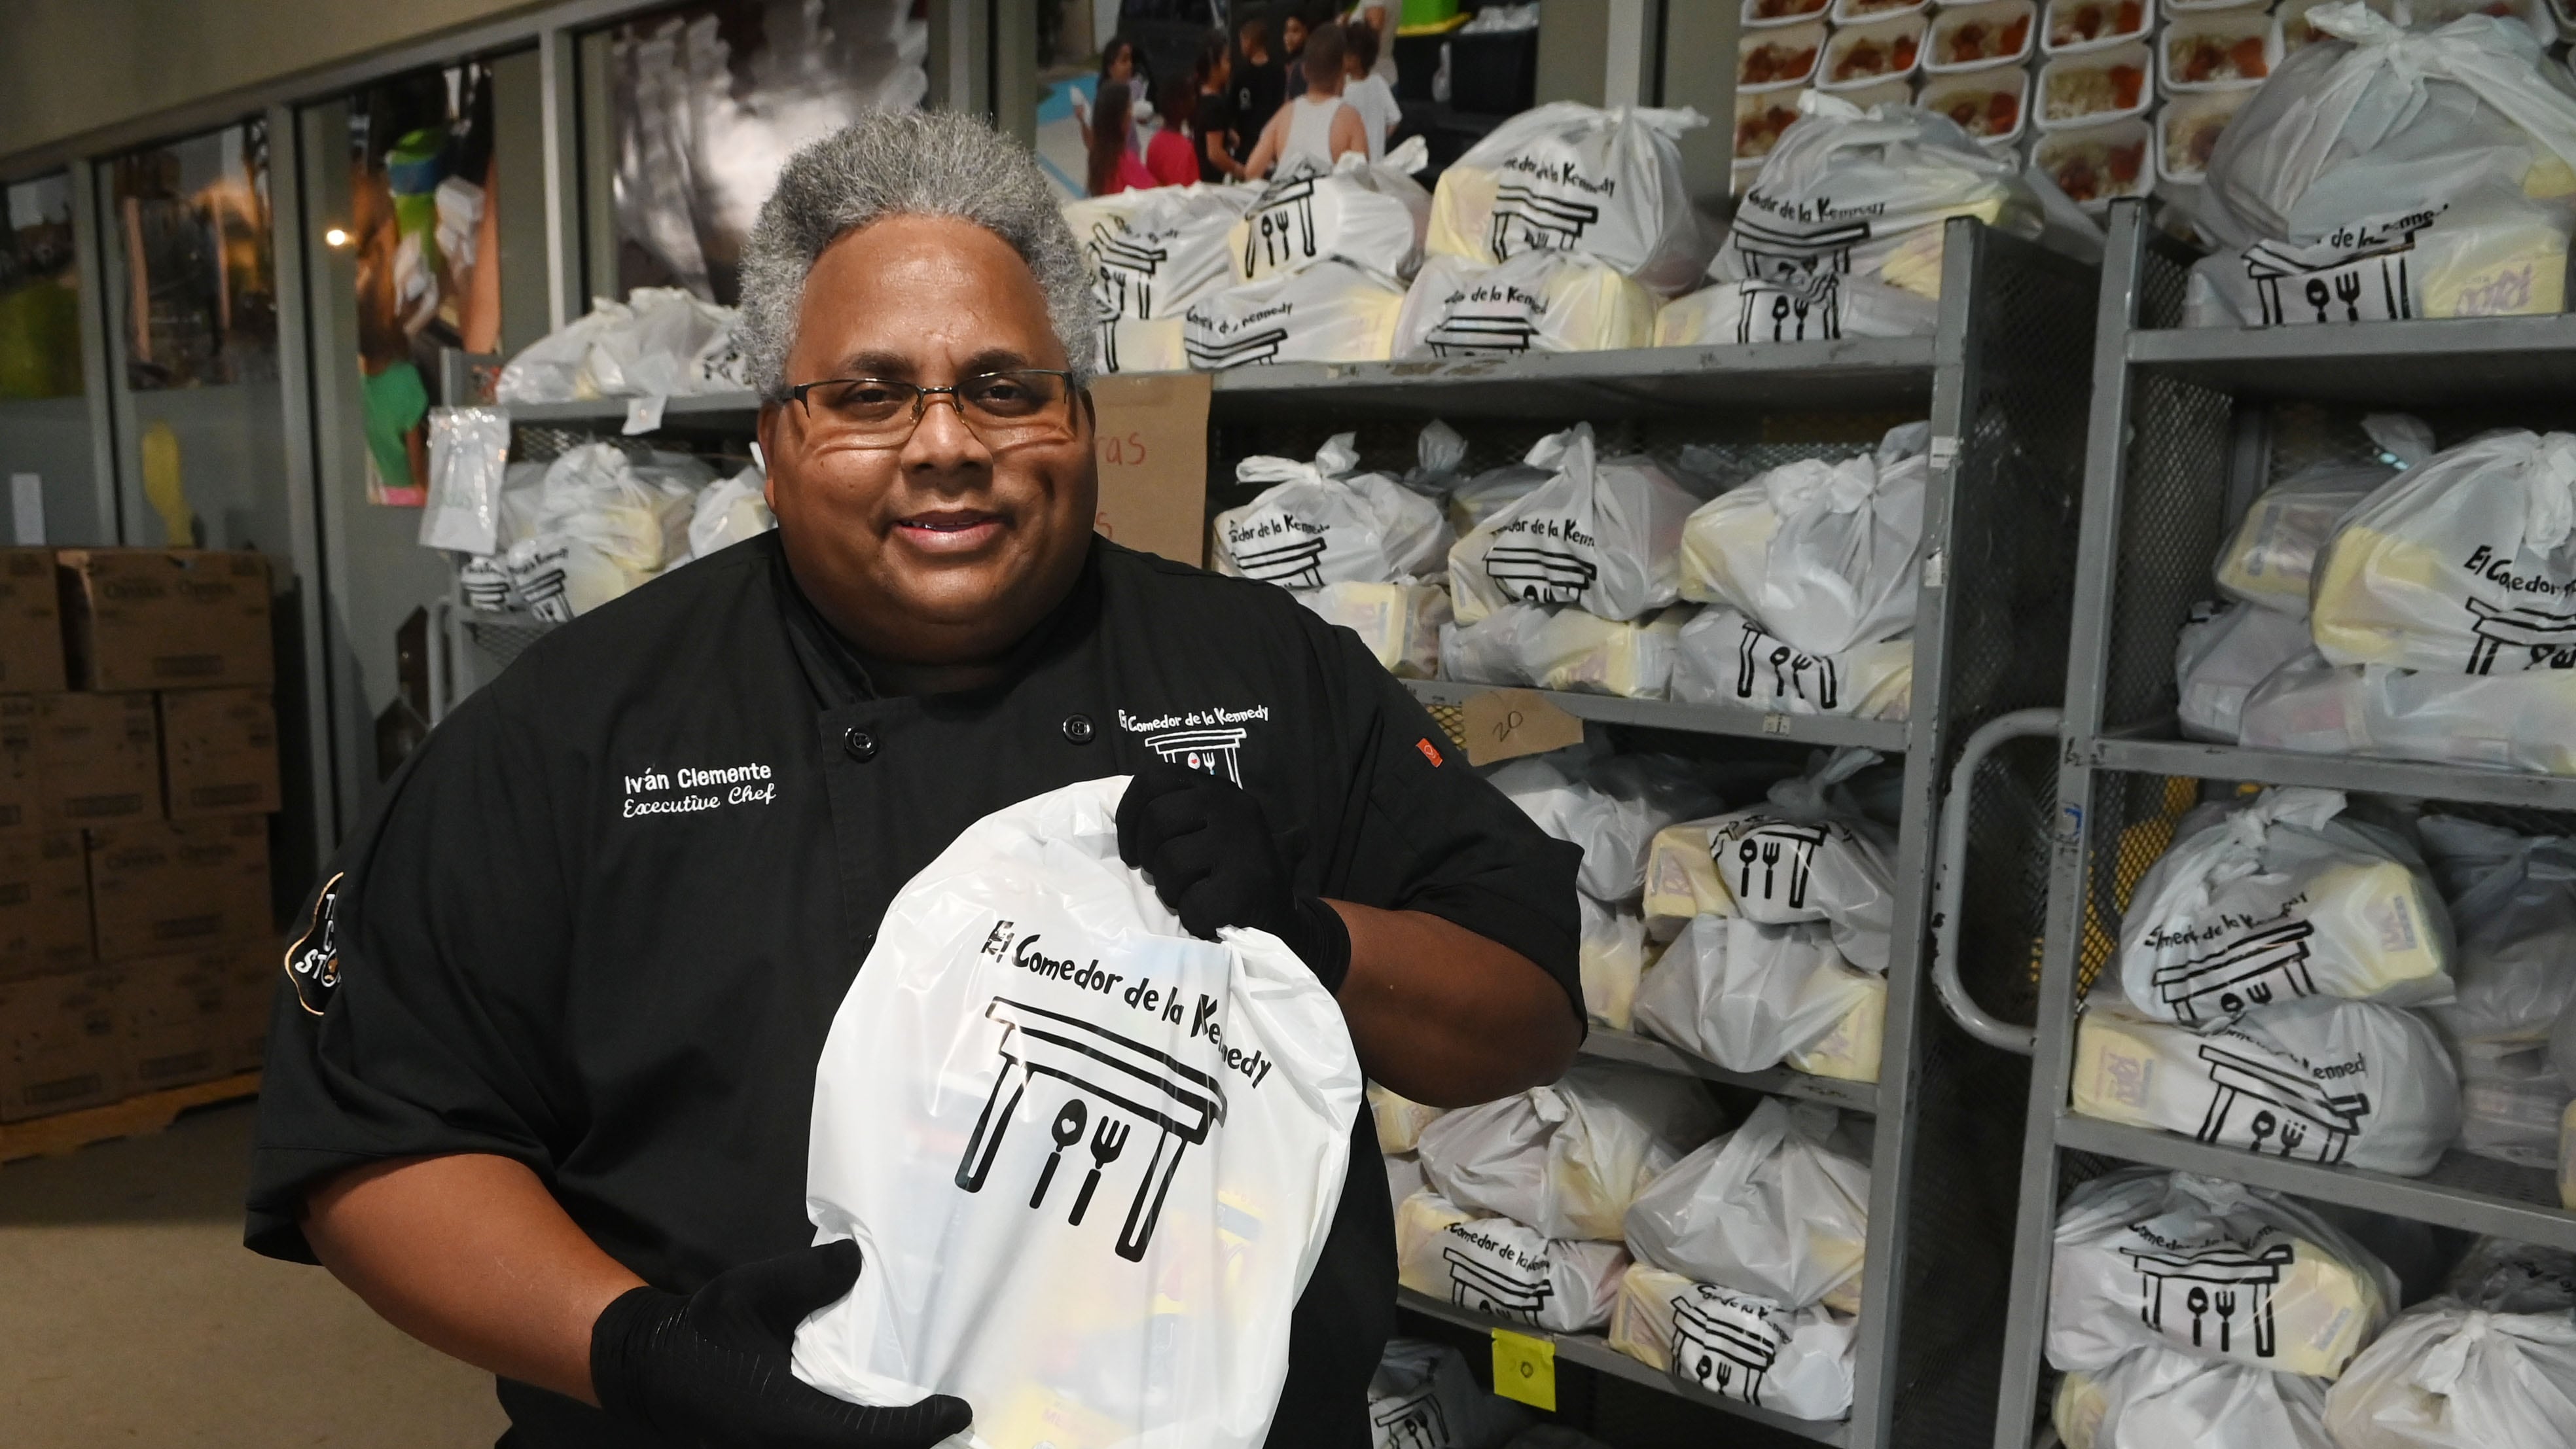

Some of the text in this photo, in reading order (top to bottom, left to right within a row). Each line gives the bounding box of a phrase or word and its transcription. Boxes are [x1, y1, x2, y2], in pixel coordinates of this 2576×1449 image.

[1780, 200, 1796, 221] de
[1798, 202, 1813, 223] la
[2331, 226, 2354, 249] de
[1471, 286, 1488, 302] de
[1490, 284, 1503, 302] la
[1242, 301, 1293, 328] ennedy
[1257, 522, 1271, 539] de
[1270, 518, 1282, 536] la
[1531, 518, 1545, 535] de
[1548, 519, 1559, 538] la
[1564, 518, 1596, 547] Kenn
[2463, 545, 2493, 575] El
[2486, 560, 2560, 596] Coedor
[1127, 713, 1182, 733] Comedor
[1185, 712, 1202, 726] de
[1202, 710, 1216, 726] la
[1213, 704, 1269, 726] Kennedy
[1492, 710, 1524, 743] 20
[624, 762, 772, 795] Iván Clemente
[622, 782, 777, 819] Executive Chef
[980, 920, 1014, 963] El
[1011, 934, 1124, 995] Comedor
[1124, 978, 1160, 1012] de
[1161, 986, 1185, 1026] la
[2302, 1051, 2369, 1080] enned
[1499, 1243, 1515, 1261] de
[1515, 1251, 1529, 1269] la
